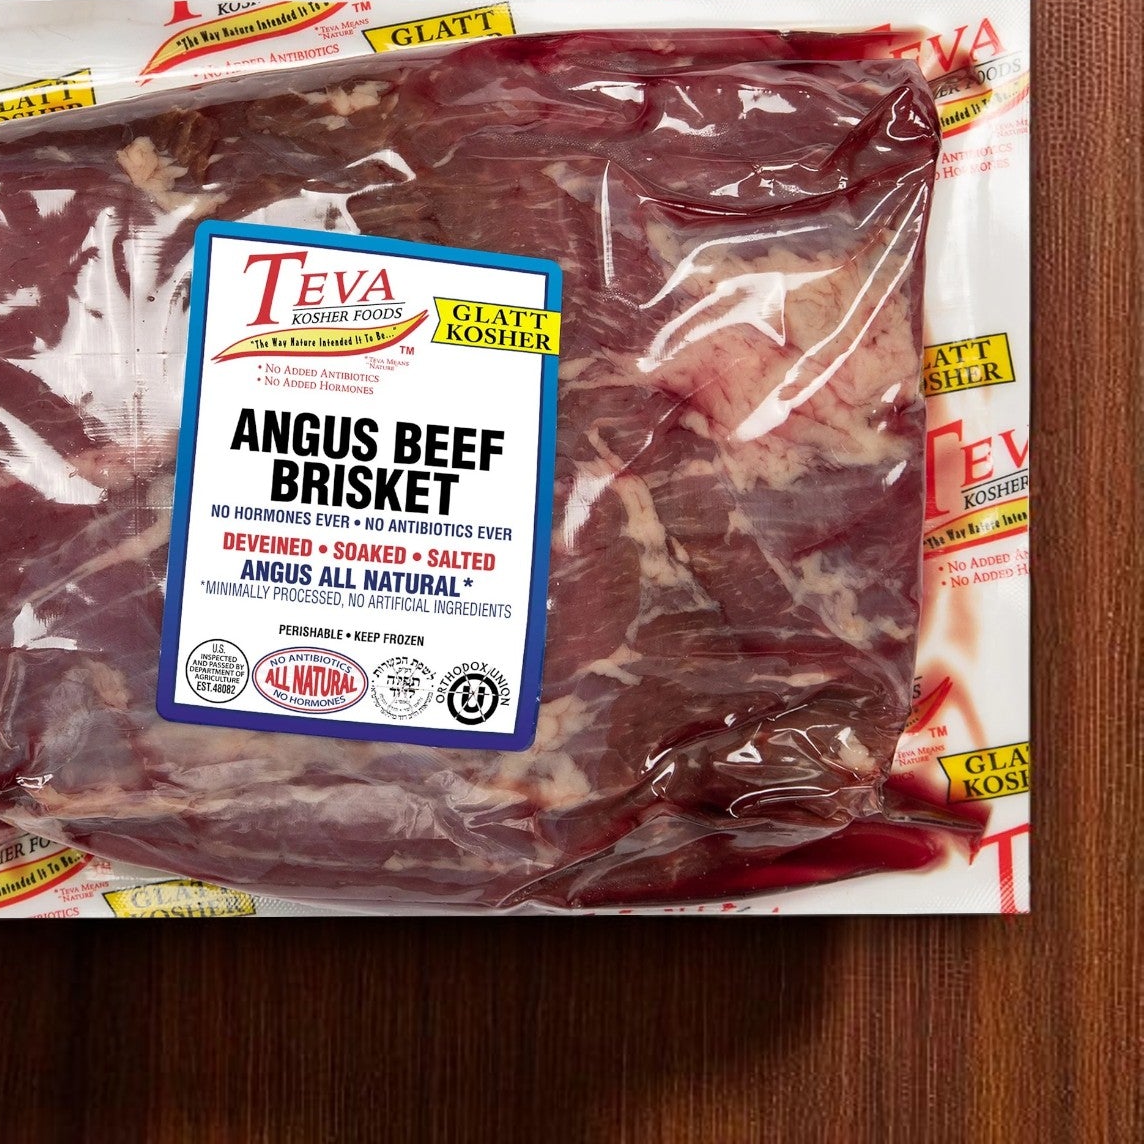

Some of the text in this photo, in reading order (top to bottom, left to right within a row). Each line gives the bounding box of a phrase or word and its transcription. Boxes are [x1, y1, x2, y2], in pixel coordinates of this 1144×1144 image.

[352, 1, 372, 13] TM
[200, 30, 220, 43] Way
[222, 22, 254, 38] Nature
[256, 9, 296, 31] Intended
[297, 5, 308, 16] It
[391, 9, 496, 46] GLATT
[269, 44, 340, 64] ANTIBIOTICS
[243, 251, 395, 326] TEVA
[292, 308, 403, 326] KOSHER FOODS
[453, 304, 549, 330] GLATT
[272, 337, 287, 348] Way
[290, 337, 316, 347] Nature
[319, 334, 353, 347] Intended
[355, 333, 362, 344] It
[365, 332, 374, 343] To
[446, 323, 551, 352] KOSHER
[399, 345, 415, 355] TM
[284, 365, 317, 377] ADDED
[321, 369, 380, 383] ANTIBIOTICS
[283, 378, 317, 390] ADDED
[320, 381, 374, 395] HORMONES
[230, 408, 505, 472] ANGUS BEEF
[270, 457, 460, 516] BRISKET
[211, 504, 512, 541] NO HORMONES EVER NO ANTIBIOTICS EVER
[223, 532, 496, 571] DEVEINED SOAKED SALTED
[970, 553, 1010, 570] ADDED
[240, 559, 312, 585] ANGUS
[319, 566, 356, 589] ALL
[273, 587, 344, 608] PROCESSED,
[348, 593, 365, 608] NO
[368, 594, 430, 613] ARTIFICIAL
[434, 600, 512, 619] INGREDIENTS
[279, 624, 425, 646] PERISHABLE KEEP FROZEN
[201, 653, 237, 662] INSPECTED
[212, 643, 226, 654] U.S.
[190, 666, 234, 676] DEPARTMENT
[209, 661, 234, 669] PASSED
[270, 654, 353, 674] NO ANTIBIOTICS
[195, 674, 240, 684] AGRICULTURE
[197, 681, 235, 694] EST.48082
[265, 666, 290, 692] ALL
[293, 665, 358, 697] NATURAL
[436, 661, 488, 704] ORTHODOX
[489, 668, 511, 706] UNION
[273, 689, 346, 707] NO HORMONES
[928, 726, 948, 738] TM
[37, 869, 48, 880] It
[49, 863, 60, 875] To
